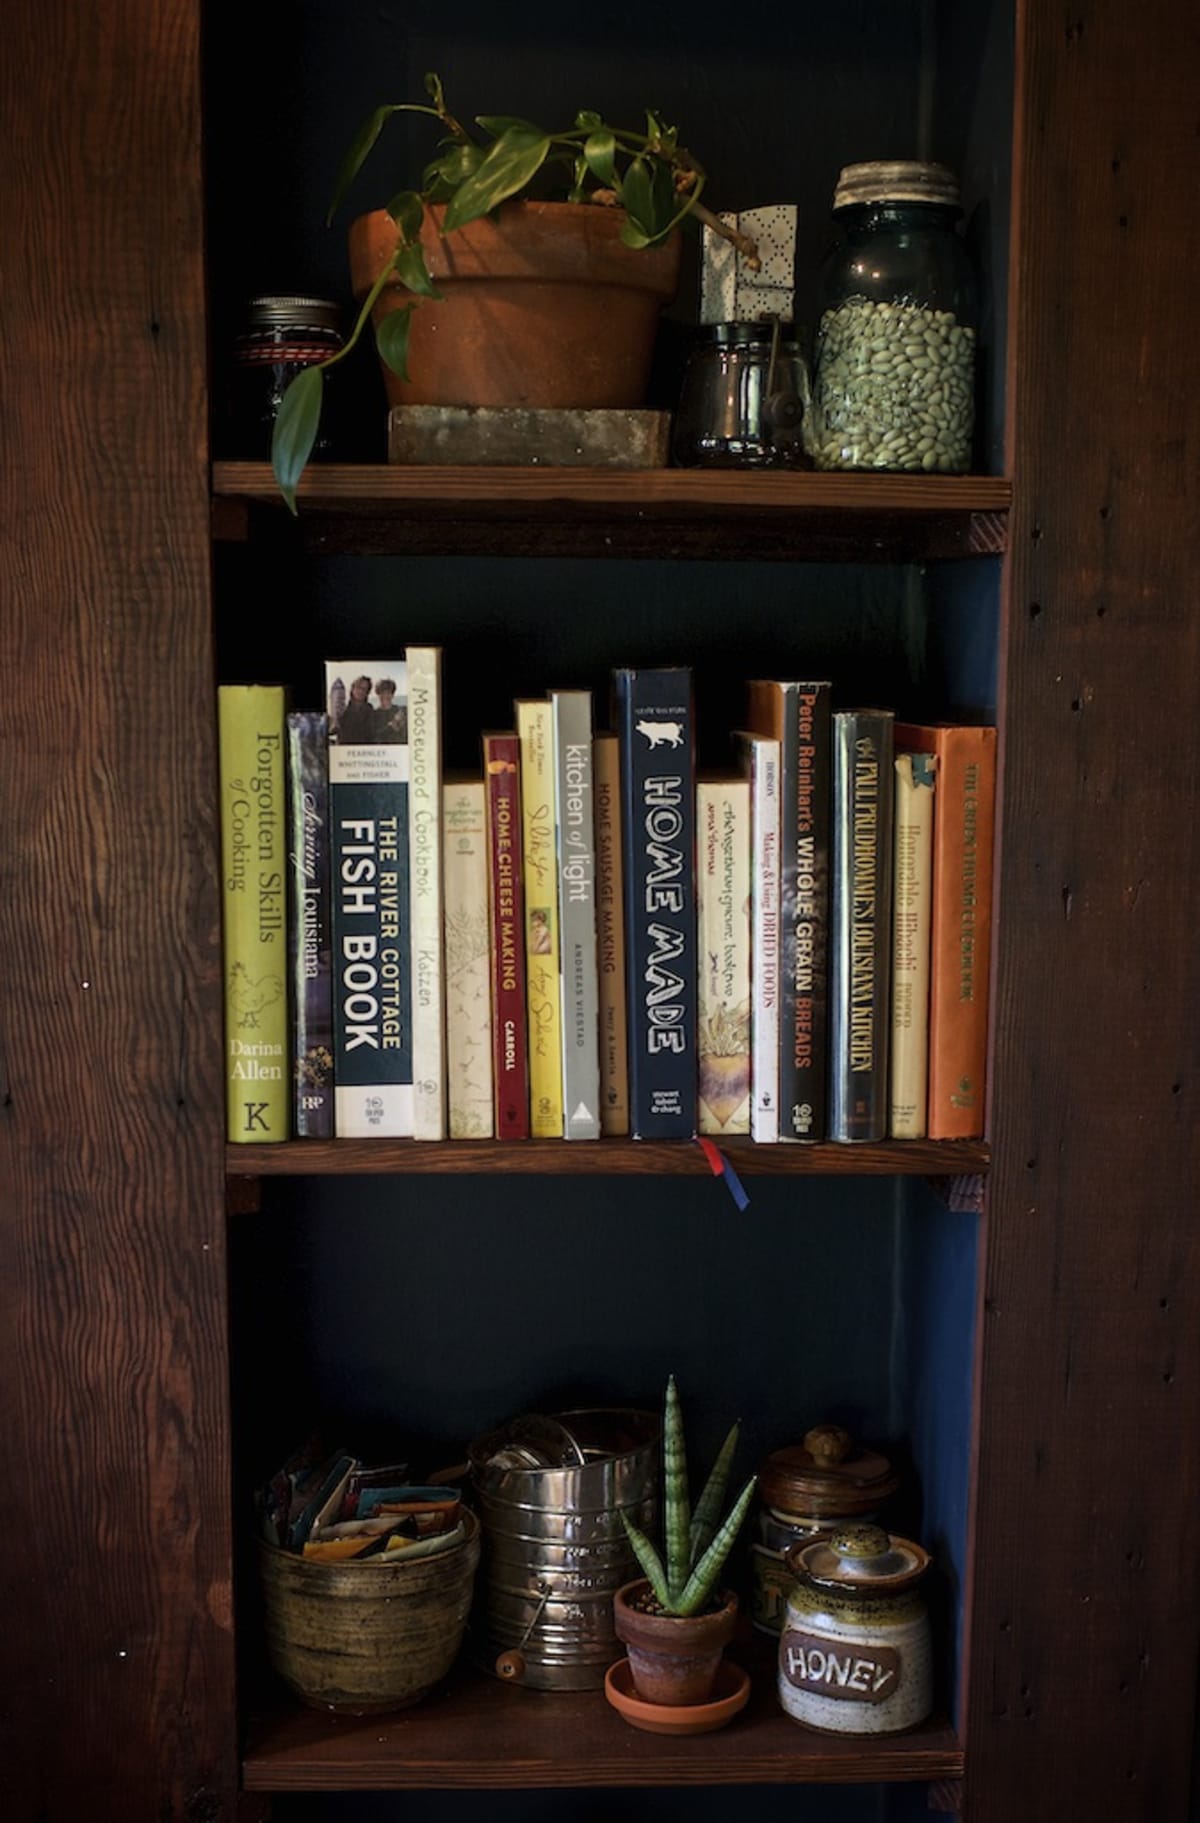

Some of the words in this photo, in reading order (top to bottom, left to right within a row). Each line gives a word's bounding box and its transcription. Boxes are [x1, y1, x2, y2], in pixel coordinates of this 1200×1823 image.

[411, 687, 430, 799] Moosewood
[798, 693, 818, 742] Peter
[228, 778, 249, 797] of
[250, 732, 281, 861] Forgotten
[565, 744, 589, 826] kitchen
[598, 783, 613, 830] HOME
[797, 745, 817, 833] Reinhart's
[854, 762, 880, 801] PAUL
[228, 799, 251, 892] Cooking
[290, 791, 323, 880] Serving
[379, 816, 398, 863] THE
[415, 809, 435, 899] Cookbook
[497, 796, 512, 850] HOME
[567, 830, 588, 852] of
[644, 776, 685, 913] HOME
[761, 832, 776, 869] Making
[341, 819, 377, 915] FISH
[499, 852, 514, 917] CHEESE
[562, 853, 592, 903] light
[599, 835, 615, 905] SAUSAGE
[762, 870, 777, 881] &
[762, 881, 776, 909] Using
[796, 836, 816, 915] WHOLE
[896, 824, 922, 908] Honorable
[259, 872, 283, 943] Skills
[302, 887, 323, 980] Louisiana
[380, 872, 399, 939] RIVER
[763, 912, 778, 957] DRIED
[501, 921, 517, 991] MAKING
[574, 943, 585, 996] ANDREAS
[602, 911, 616, 974] MAKING
[795, 922, 815, 992] GRAIN
[851, 922, 876, 1003] LOUISIANA
[894, 911, 919, 971] Hibachi
[343, 935, 379, 1053] BOOK
[381, 948, 402, 1051] COTTAGE
[418, 950, 436, 1008] Katzen
[643, 923, 686, 1054] MADE
[763, 962, 778, 1010] FOODS
[231, 1040, 283, 1056] Darina
[504, 1020, 516, 1071] CARROLL
[575, 999, 586, 1048] VIESTAD
[794, 996, 814, 1069] BREADS
[850, 1006, 875, 1073] KITCHEN
[230, 1060, 283, 1081] Allen
[243, 1103, 271, 1132] K
[786, 1646, 895, 1692] HONEY
